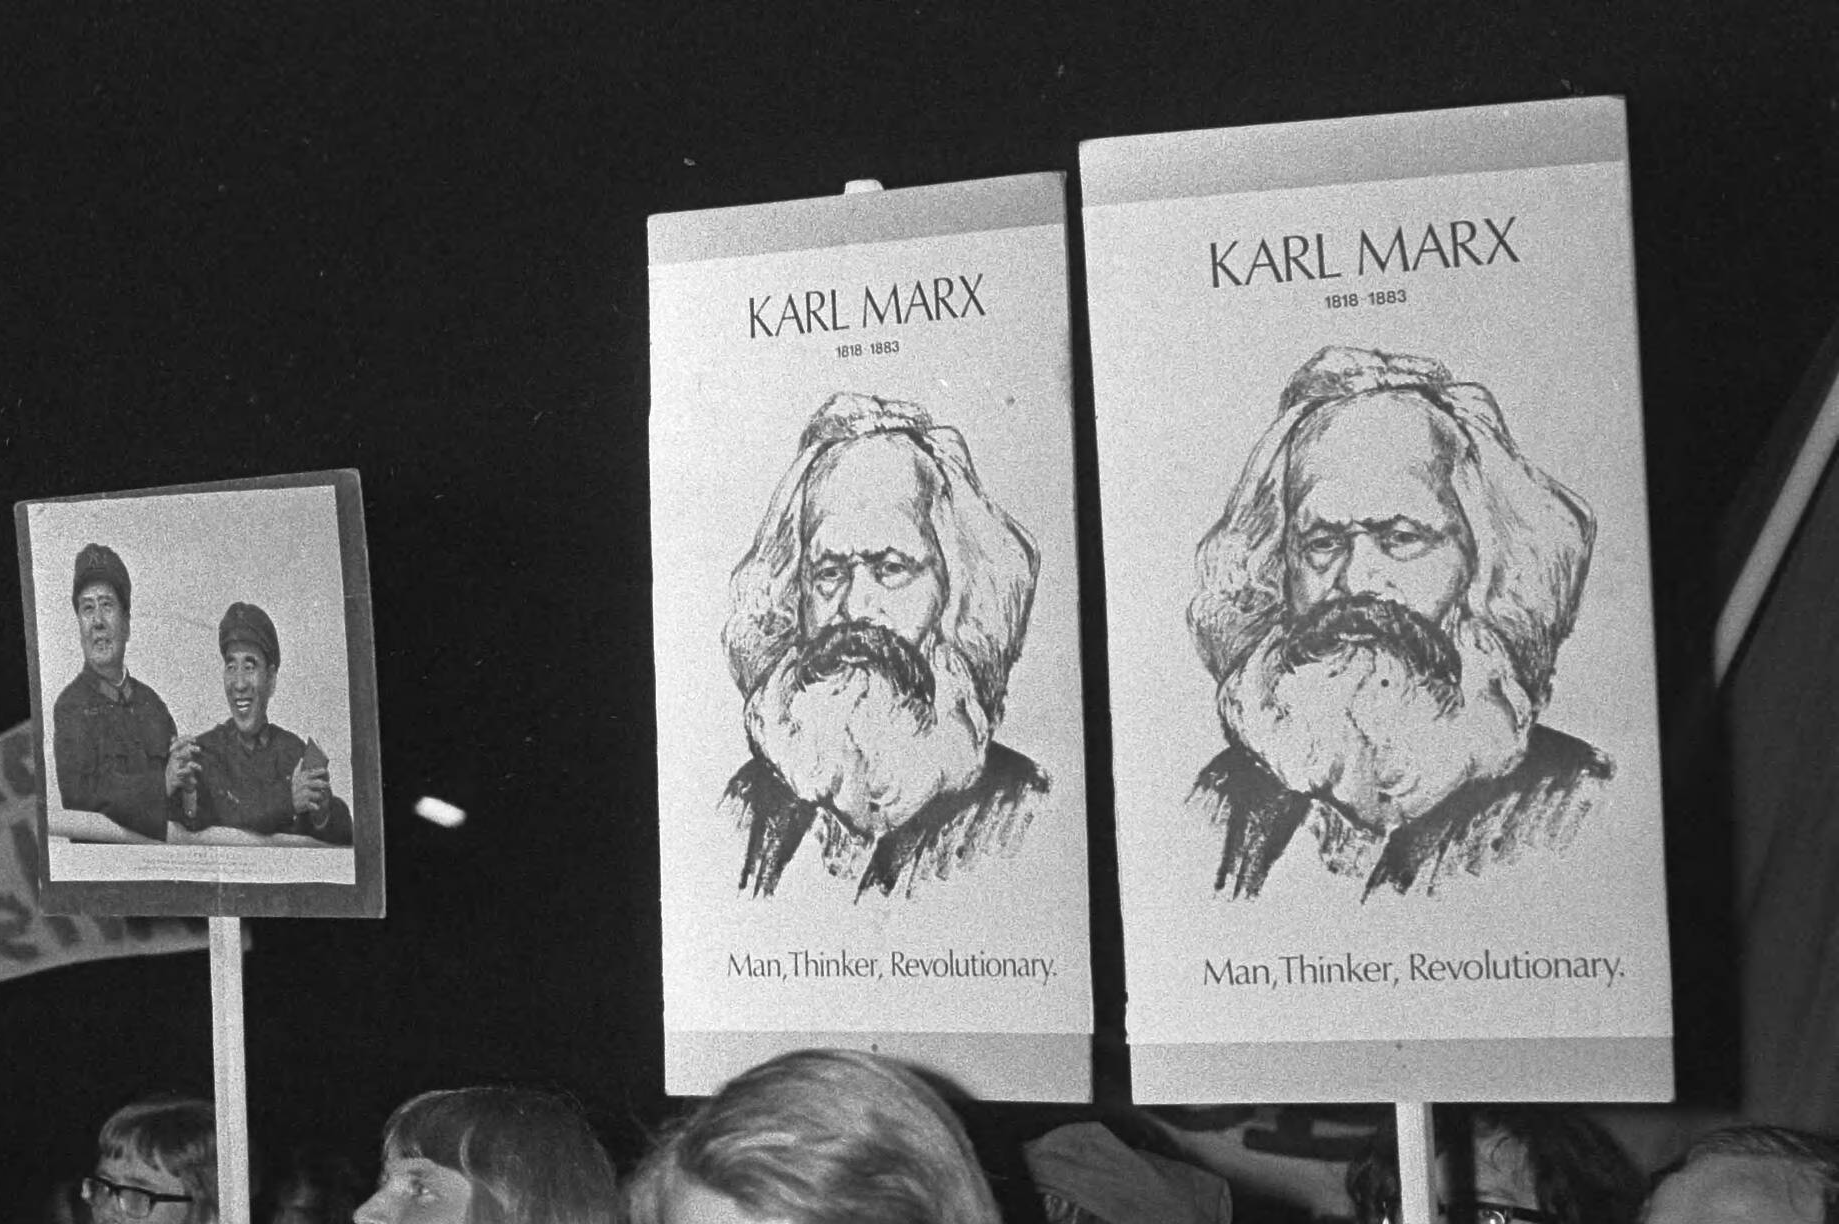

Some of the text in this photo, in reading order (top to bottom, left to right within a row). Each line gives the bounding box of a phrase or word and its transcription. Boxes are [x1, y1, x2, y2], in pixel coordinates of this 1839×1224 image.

[1210, 216, 1521, 289] KARL MARX
[749, 273, 987, 339] KARL MARX
[727, 949, 1059, 985] Man, Thinker, Revolutionary.
[1203, 949, 1626, 990] Man, Thinker, Revolutionary.
